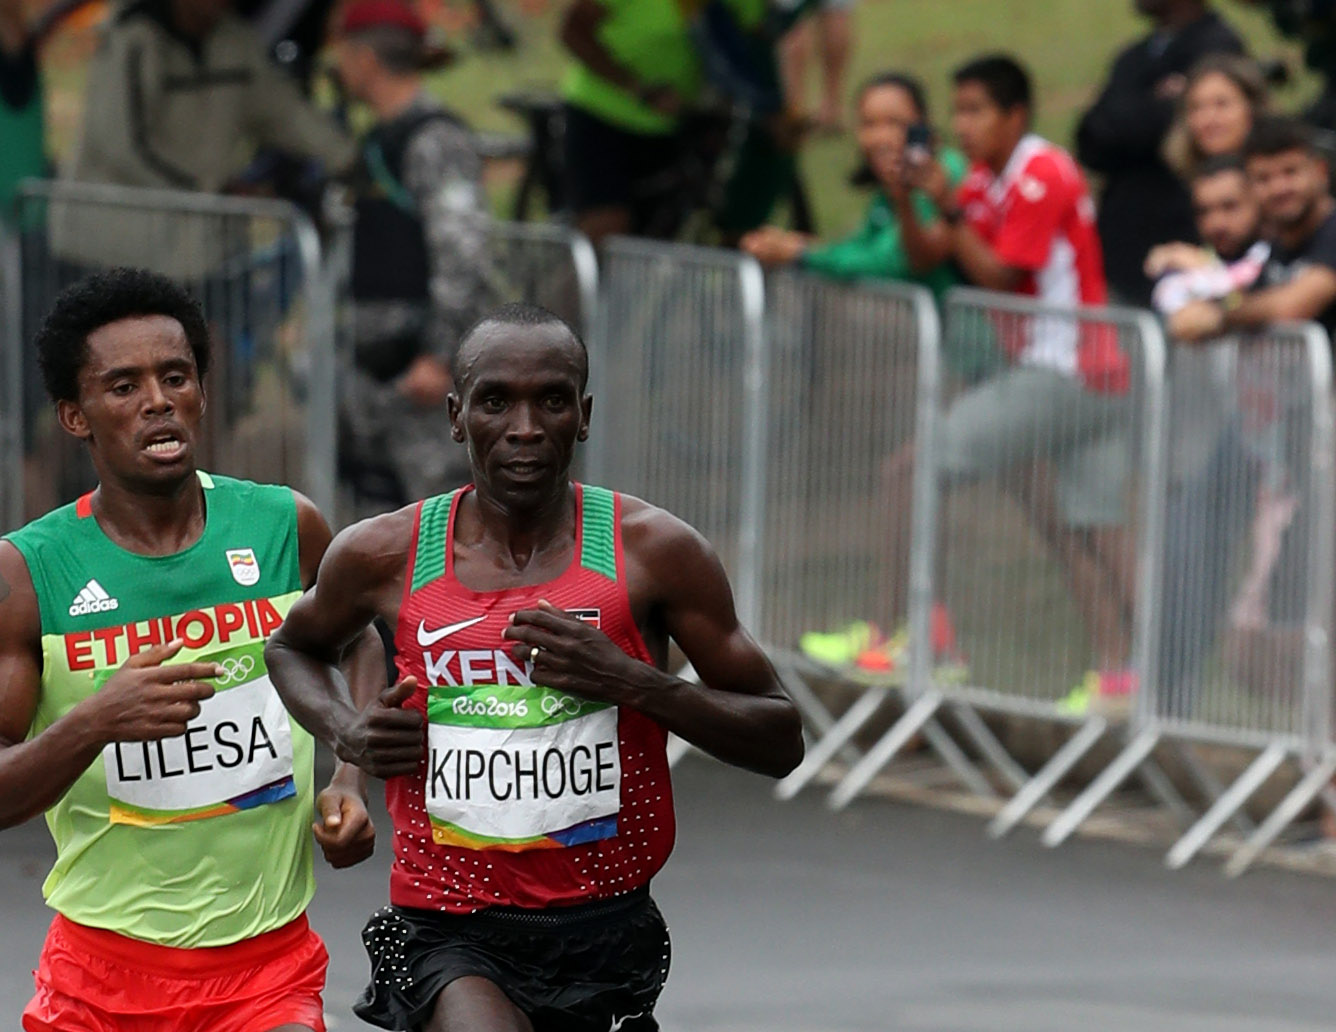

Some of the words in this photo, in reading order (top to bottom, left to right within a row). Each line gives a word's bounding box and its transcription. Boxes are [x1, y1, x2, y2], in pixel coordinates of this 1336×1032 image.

[64, 597, 284, 672] ETHIOPIA
[69, 598, 119, 617] adidas
[115, 716, 278, 782] LILESA
[430, 741, 615, 802] KIPCHOGE
